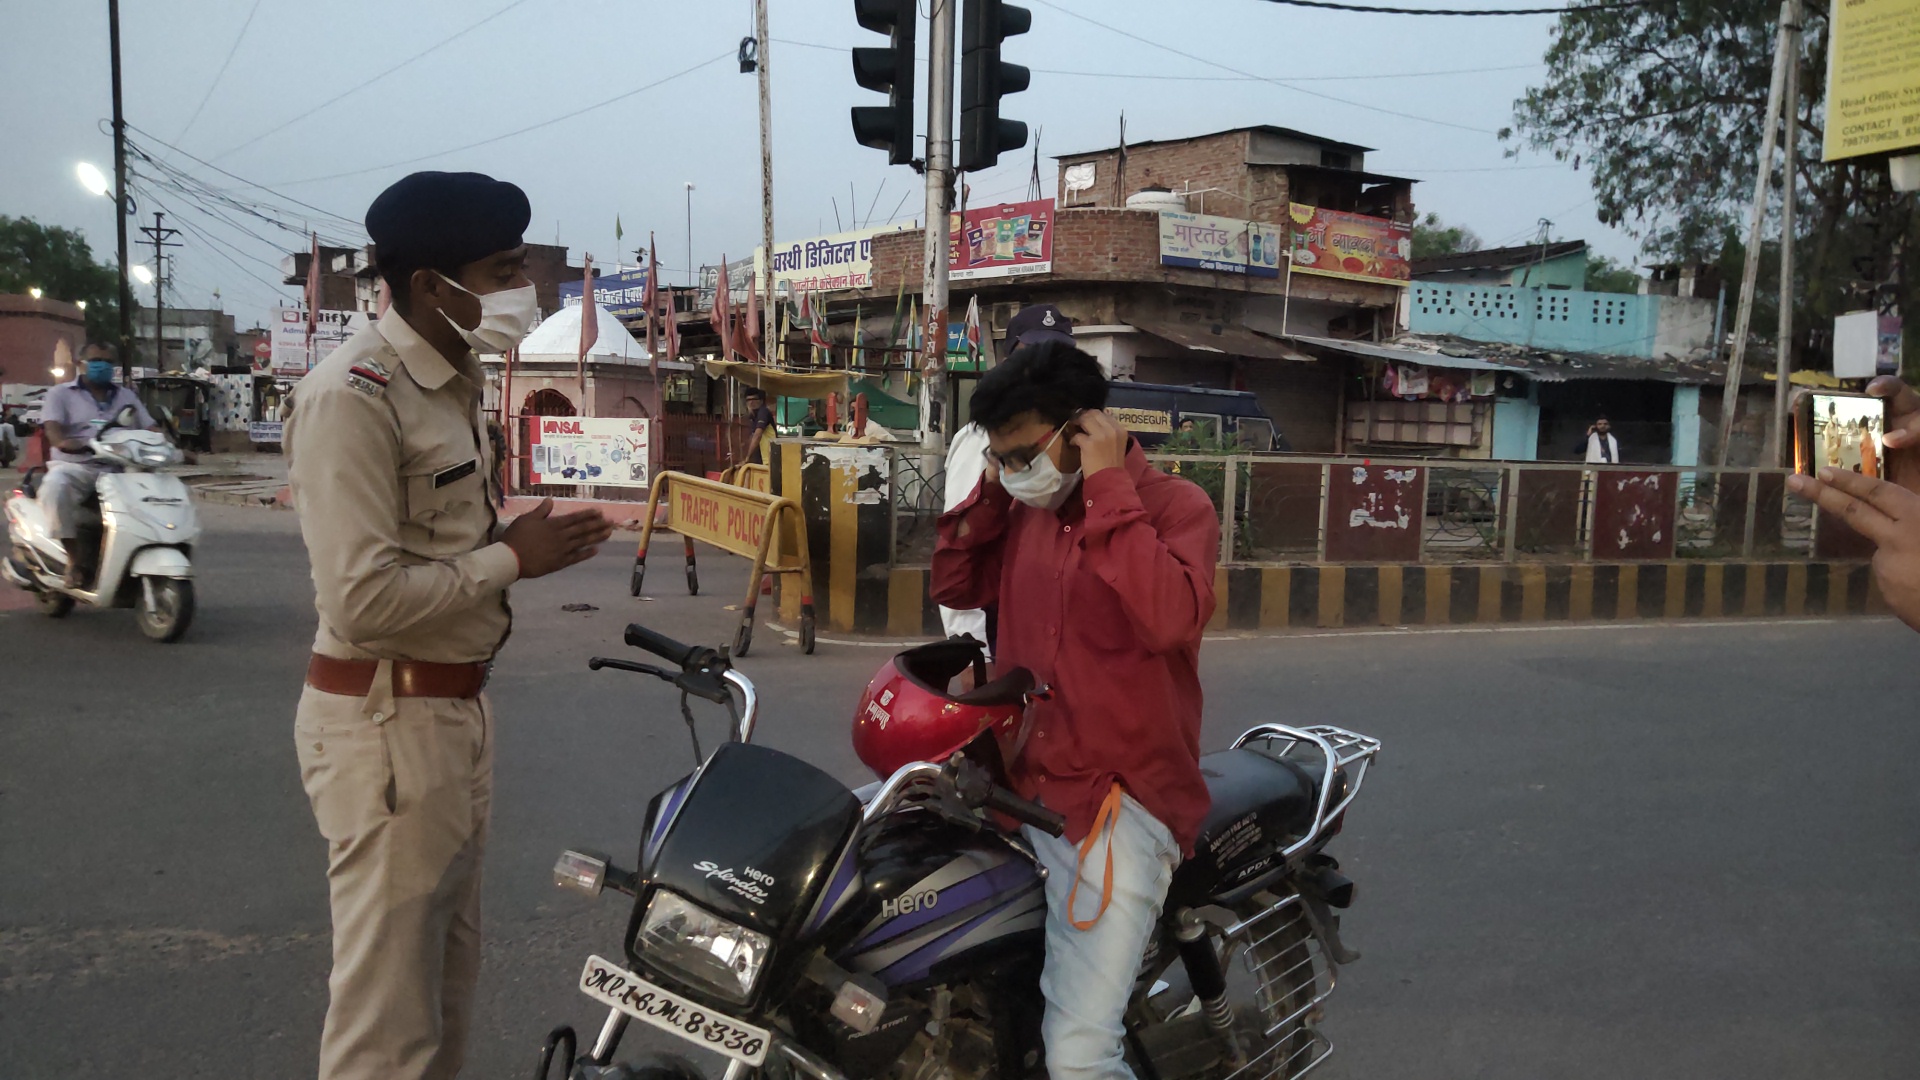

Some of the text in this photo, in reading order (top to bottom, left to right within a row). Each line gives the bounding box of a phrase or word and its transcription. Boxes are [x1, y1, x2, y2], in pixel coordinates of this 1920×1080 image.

[1840, 96, 1866, 109] Head
[1868, 90, 1898, 104] Office
[1842, 119, 1892, 136] CONTACT
[805, 240, 856, 269] डिजिटल
[1119, 413, 1168, 426] PROSEGUR
[680, 492, 720, 532] TRAFFIC
[881, 888, 938, 918] Hero
